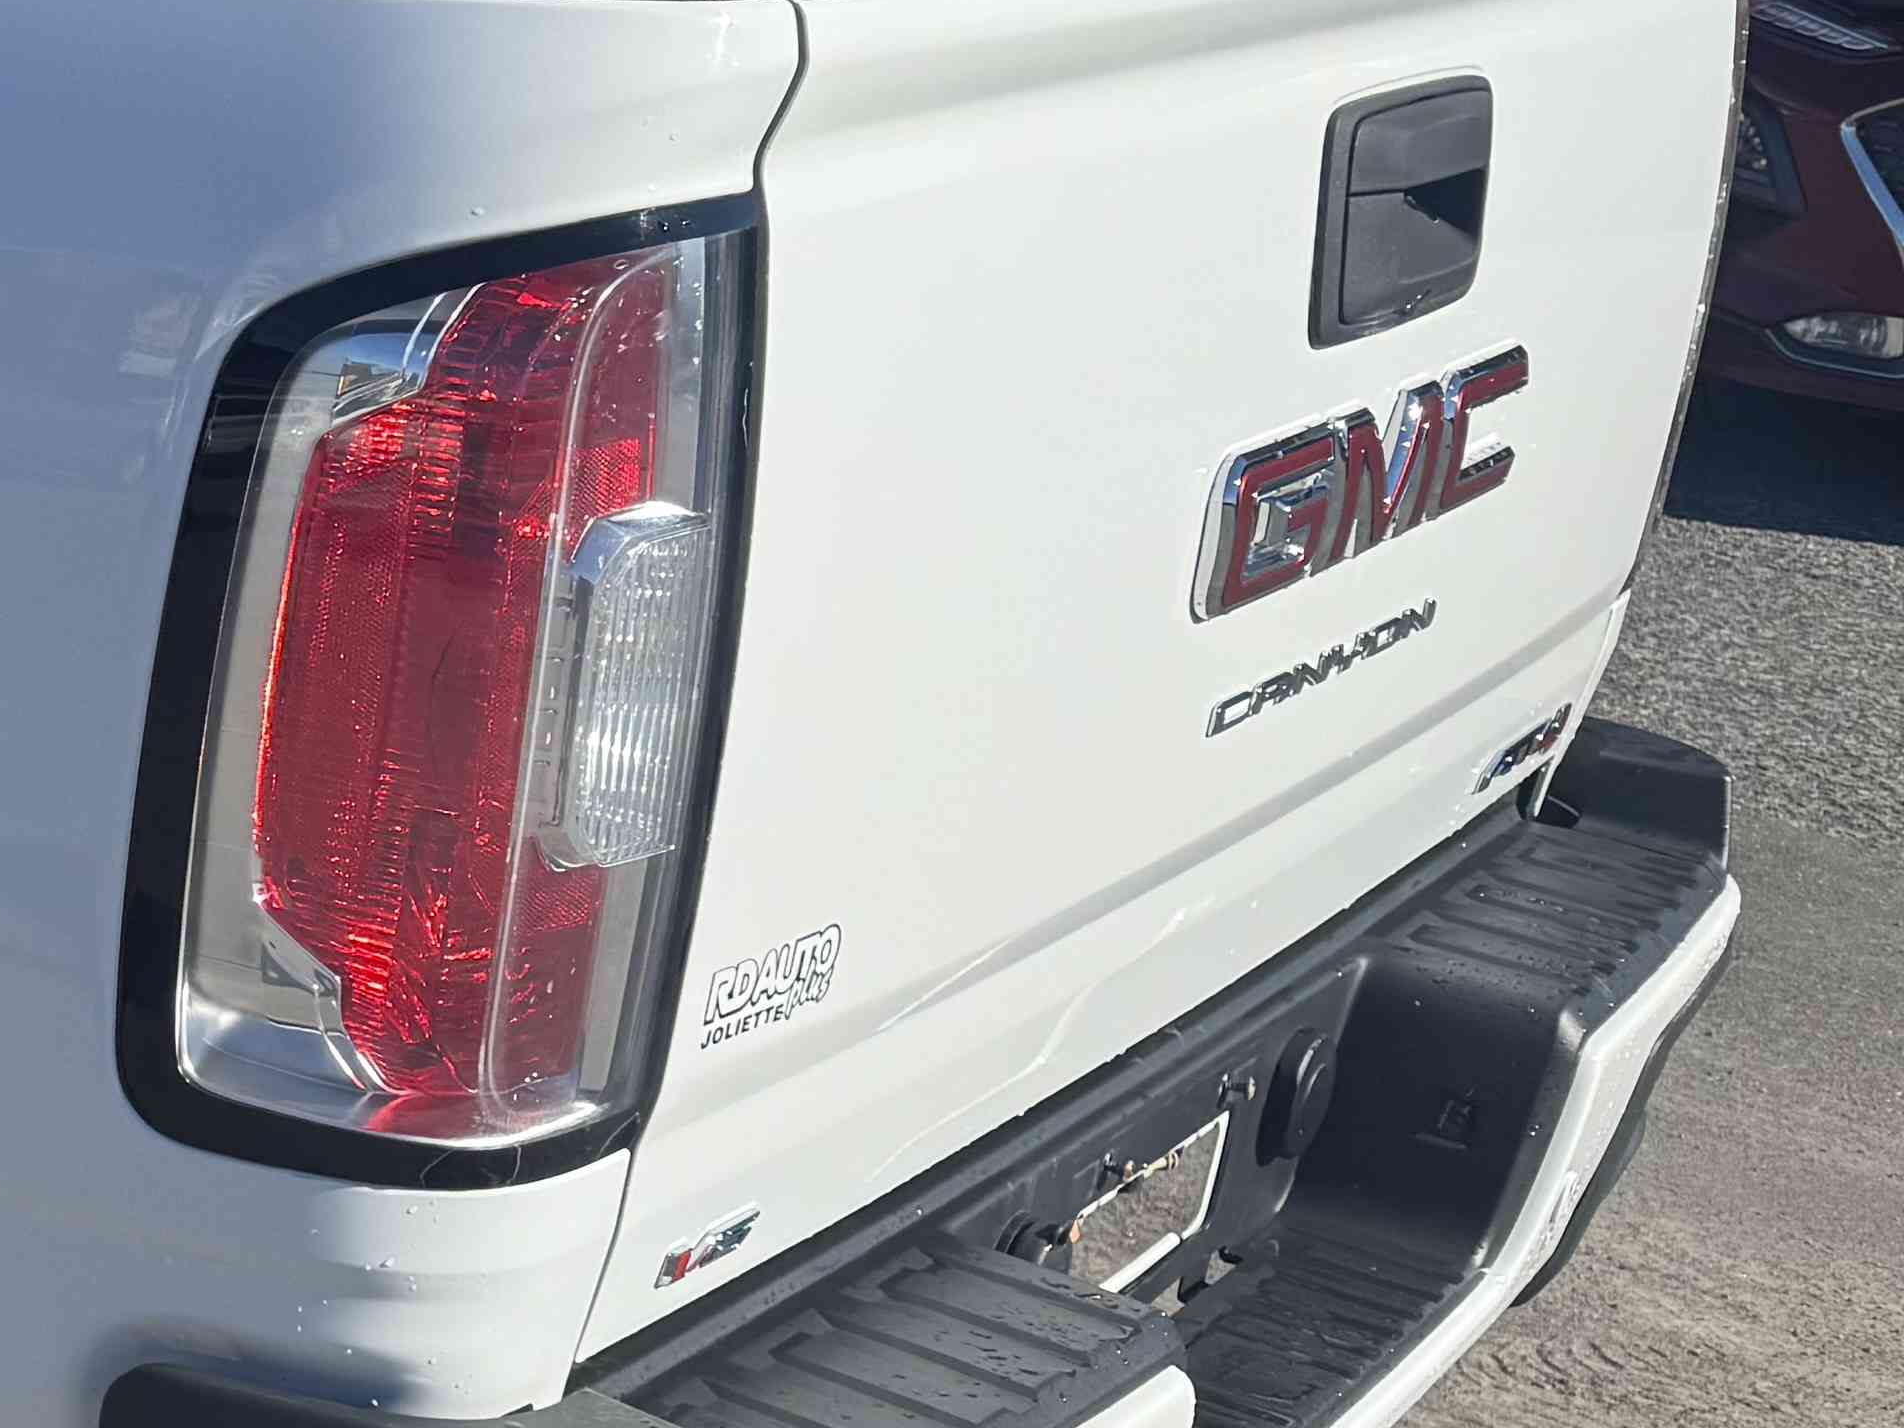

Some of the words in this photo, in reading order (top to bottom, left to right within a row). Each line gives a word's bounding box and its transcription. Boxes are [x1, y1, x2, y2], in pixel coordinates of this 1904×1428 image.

[1189, 343, 1530, 624] GMC
[1205, 597, 1438, 738] CANYON
[700, 1003, 785, 1050] JOLIETTE
